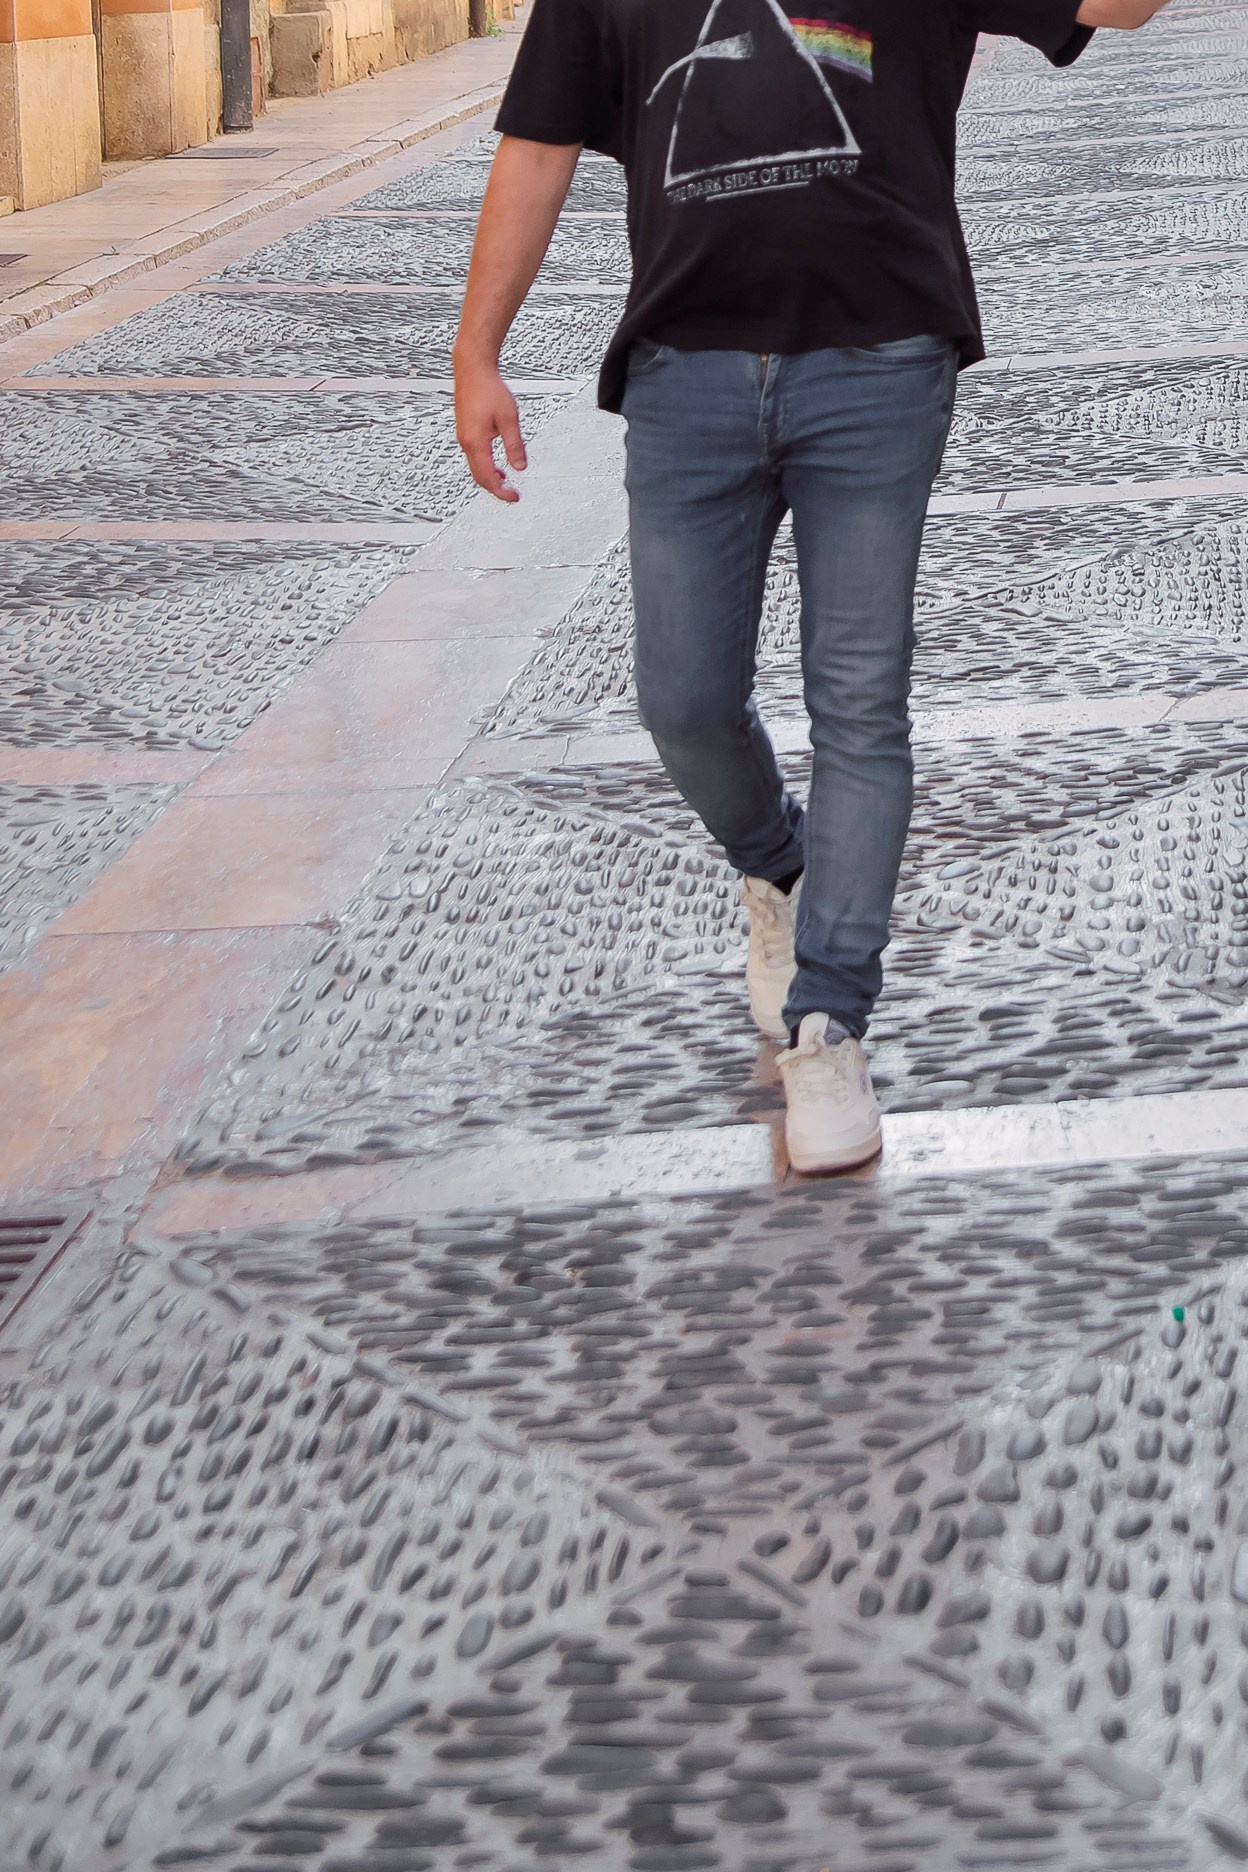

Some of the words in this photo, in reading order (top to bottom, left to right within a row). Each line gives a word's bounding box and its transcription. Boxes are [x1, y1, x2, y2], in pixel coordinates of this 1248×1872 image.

[686, 177, 722, 201] DARK
[723, 170, 759, 192] SIDE
[760, 166, 781, 187] OF
